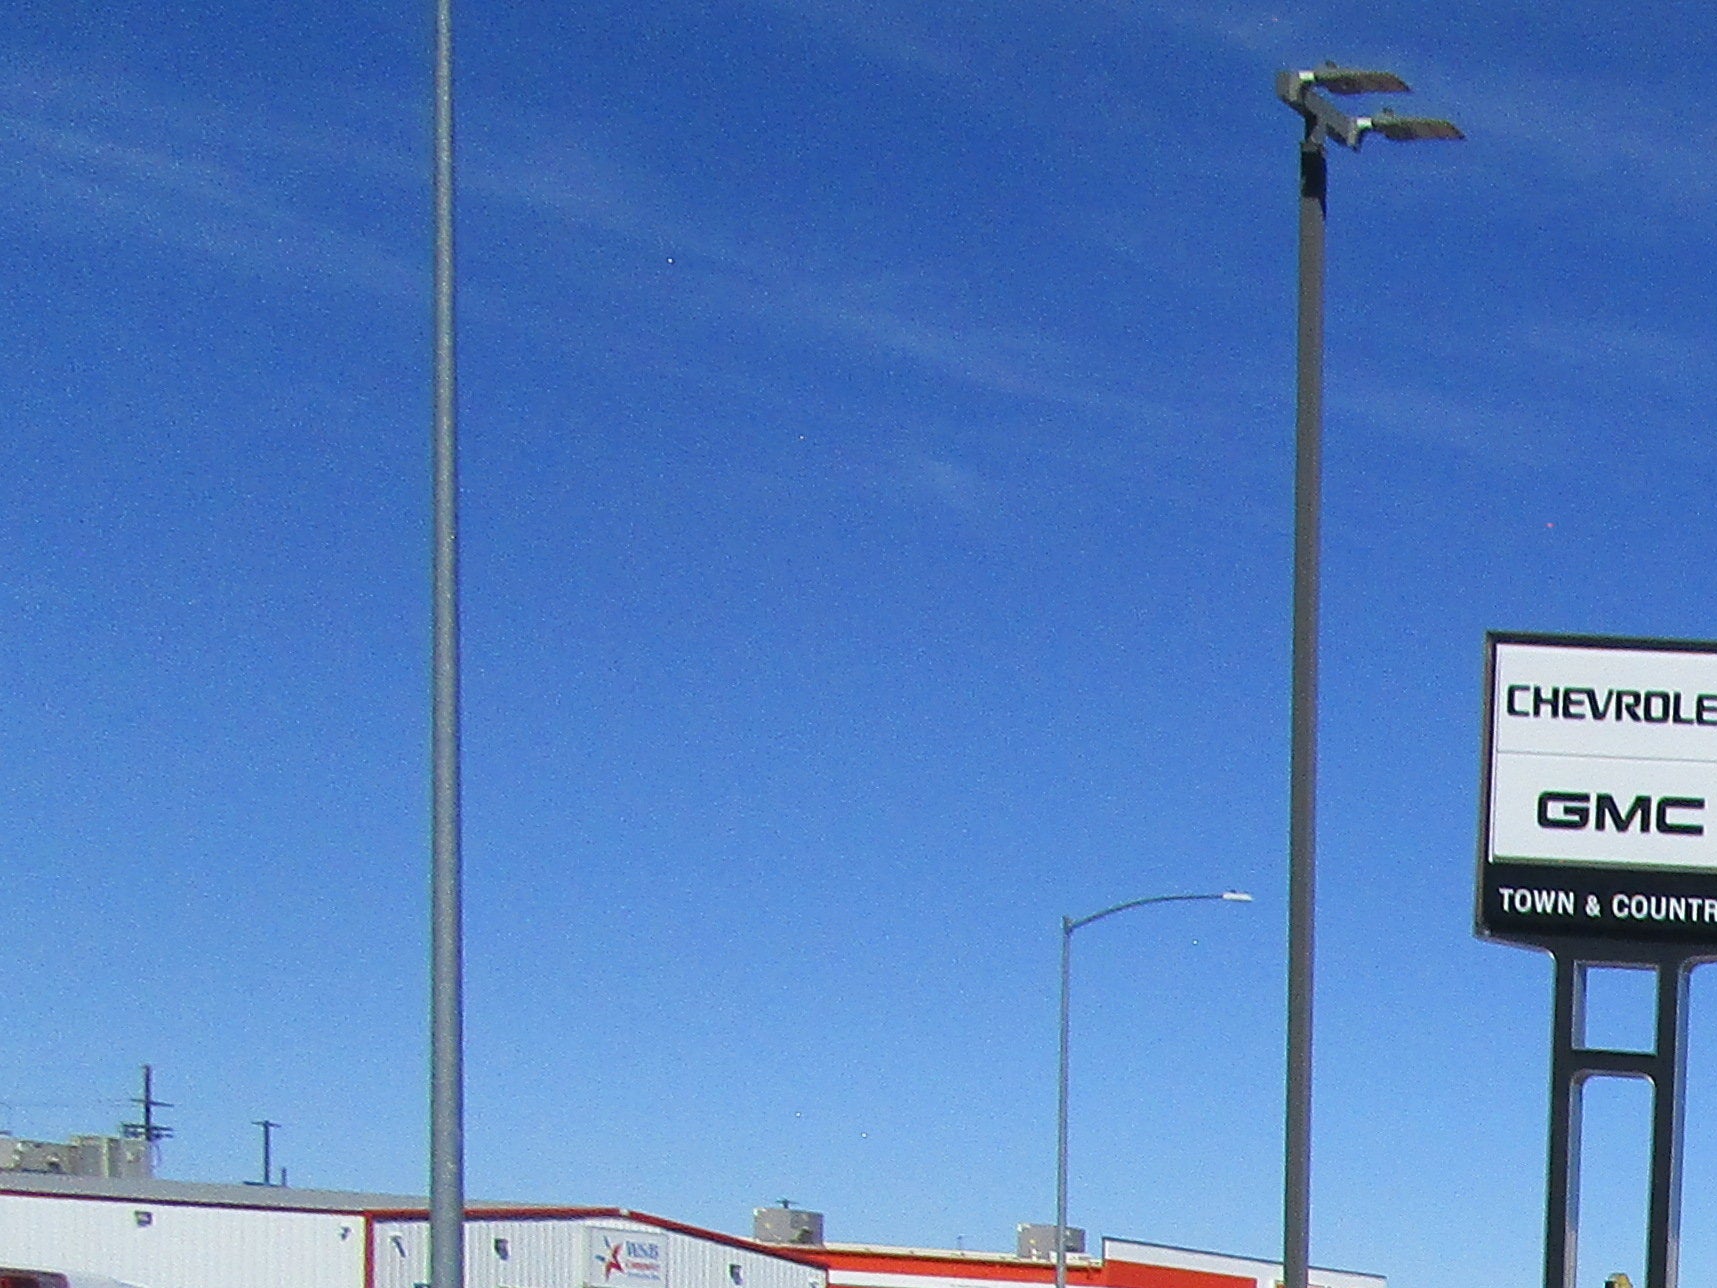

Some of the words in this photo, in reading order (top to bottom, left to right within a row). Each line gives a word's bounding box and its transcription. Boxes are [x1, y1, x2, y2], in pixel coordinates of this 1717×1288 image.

[1536, 790, 1706, 836] GMC
[1499, 887, 1575, 916] TOWN
[1584, 893, 1601, 918] &
